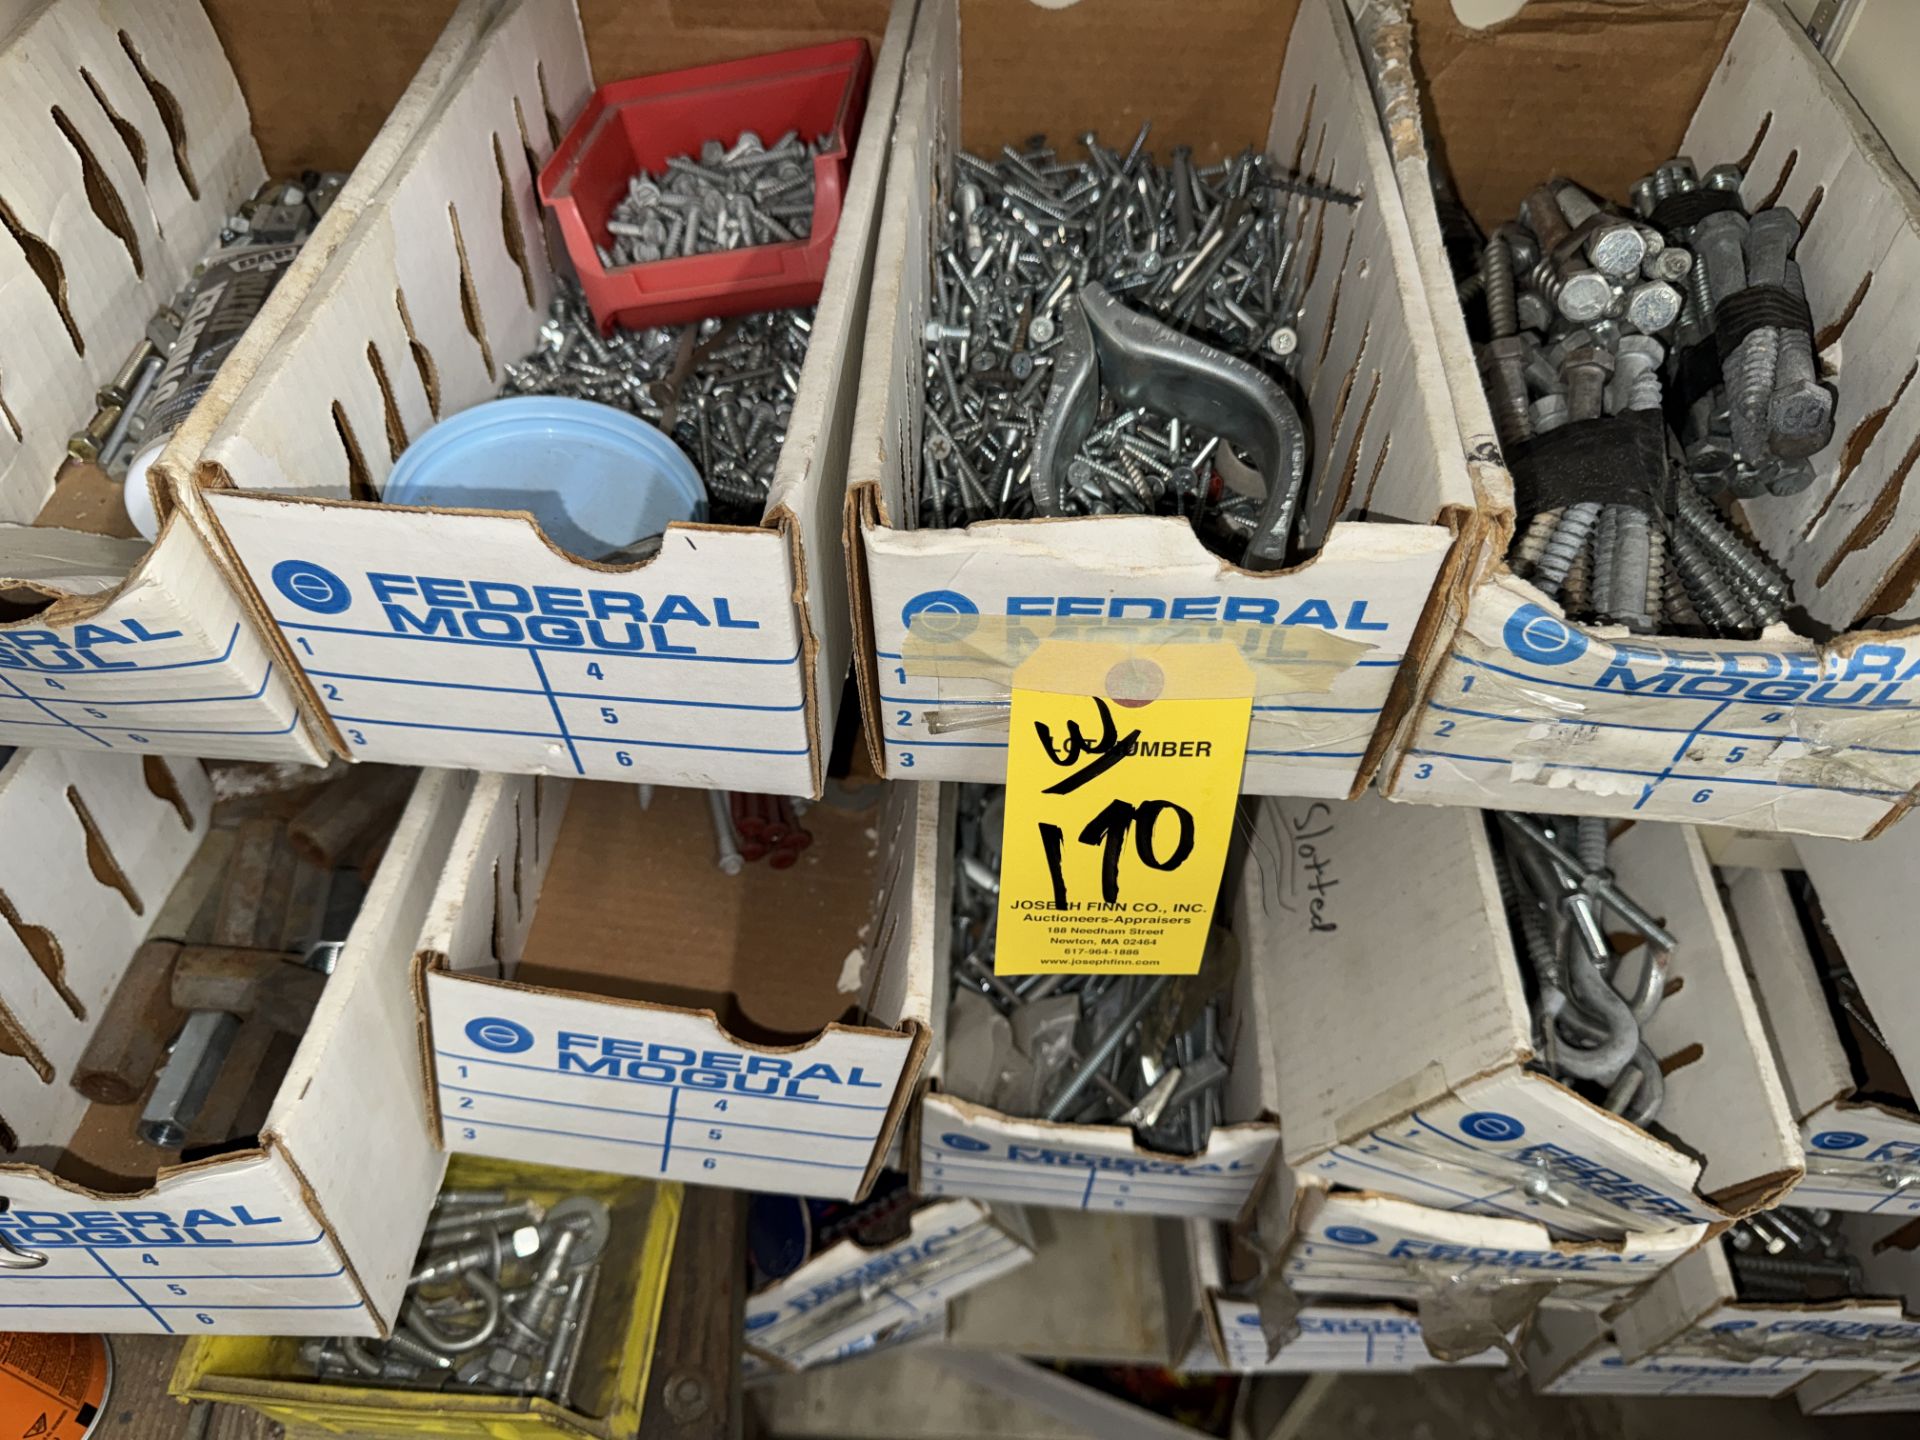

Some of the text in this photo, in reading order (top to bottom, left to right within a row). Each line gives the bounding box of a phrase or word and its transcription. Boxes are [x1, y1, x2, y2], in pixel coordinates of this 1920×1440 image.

[366, 572, 760, 629] FEDERAL
[1006, 596, 1389, 631] FEDERAL
[383, 603, 697, 655] MOGUL
[297, 637, 604, 681] 1 4
[895, 667, 907, 685] 1
[45, 677, 66, 690] 4
[1461, 675, 1784, 724] 1 4
[1594, 666, 1913, 706] MOGUL
[83, 707, 107, 719] 5
[323, 685, 619, 725] 2 5
[896, 711, 913, 727] 2
[128, 733, 149, 744] 6
[348, 730, 634, 767] 3 6
[1117, 740, 1212, 758] UMBER
[1433, 720, 1749, 763] 2 5
[900, 752, 915, 767] 3
[1414, 763, 1714, 805] 3 6
[1294, 802, 1340, 933] Slotted
[1010, 900, 1207, 913] JOSEH FINN CO., INC.
[1023, 913, 1192, 925] Auctioneers-Appraisers
[1048, 927, 1164, 936] 188 Needham Street
[1050, 937, 1097, 946] Newton,
[1123, 938, 1158, 946] 02464
[1040, 958, 1161, 967] www.josephfinn.com
[557, 1031, 882, 1088] FEDERAL
[558, 1051, 820, 1100] MOGUL
[457, 1065, 728, 1113] 1 4
[460, 1097, 722, 1141] 2 5
[462, 1128, 716, 1170] 3 6
[142, 1253, 160, 1266] 4
[166, 1283, 188, 1296] 5
[195, 1313, 215, 1325] 6
